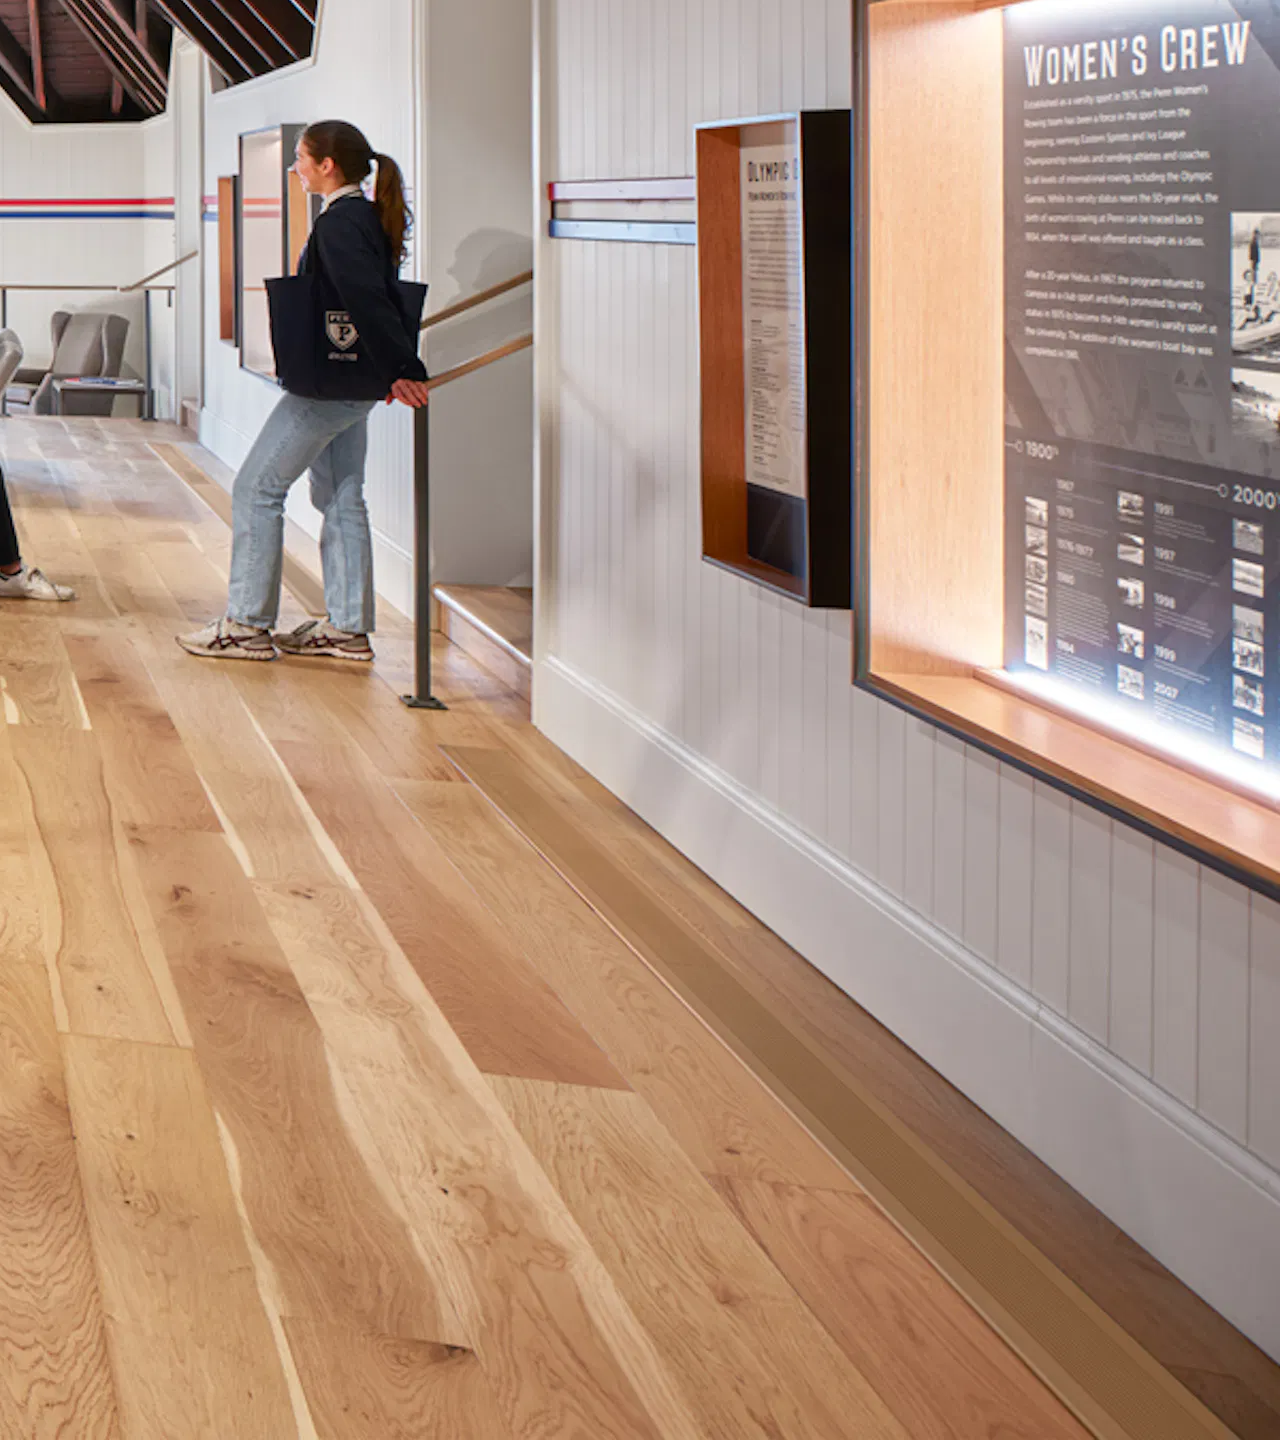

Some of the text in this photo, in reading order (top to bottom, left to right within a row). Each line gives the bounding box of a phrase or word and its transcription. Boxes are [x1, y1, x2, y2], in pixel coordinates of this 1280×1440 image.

[1023, 20, 1251, 87] WOMEN'S CREW
[748, 162, 789, 182] OLYMPIC
[339, 326, 351, 341] P
